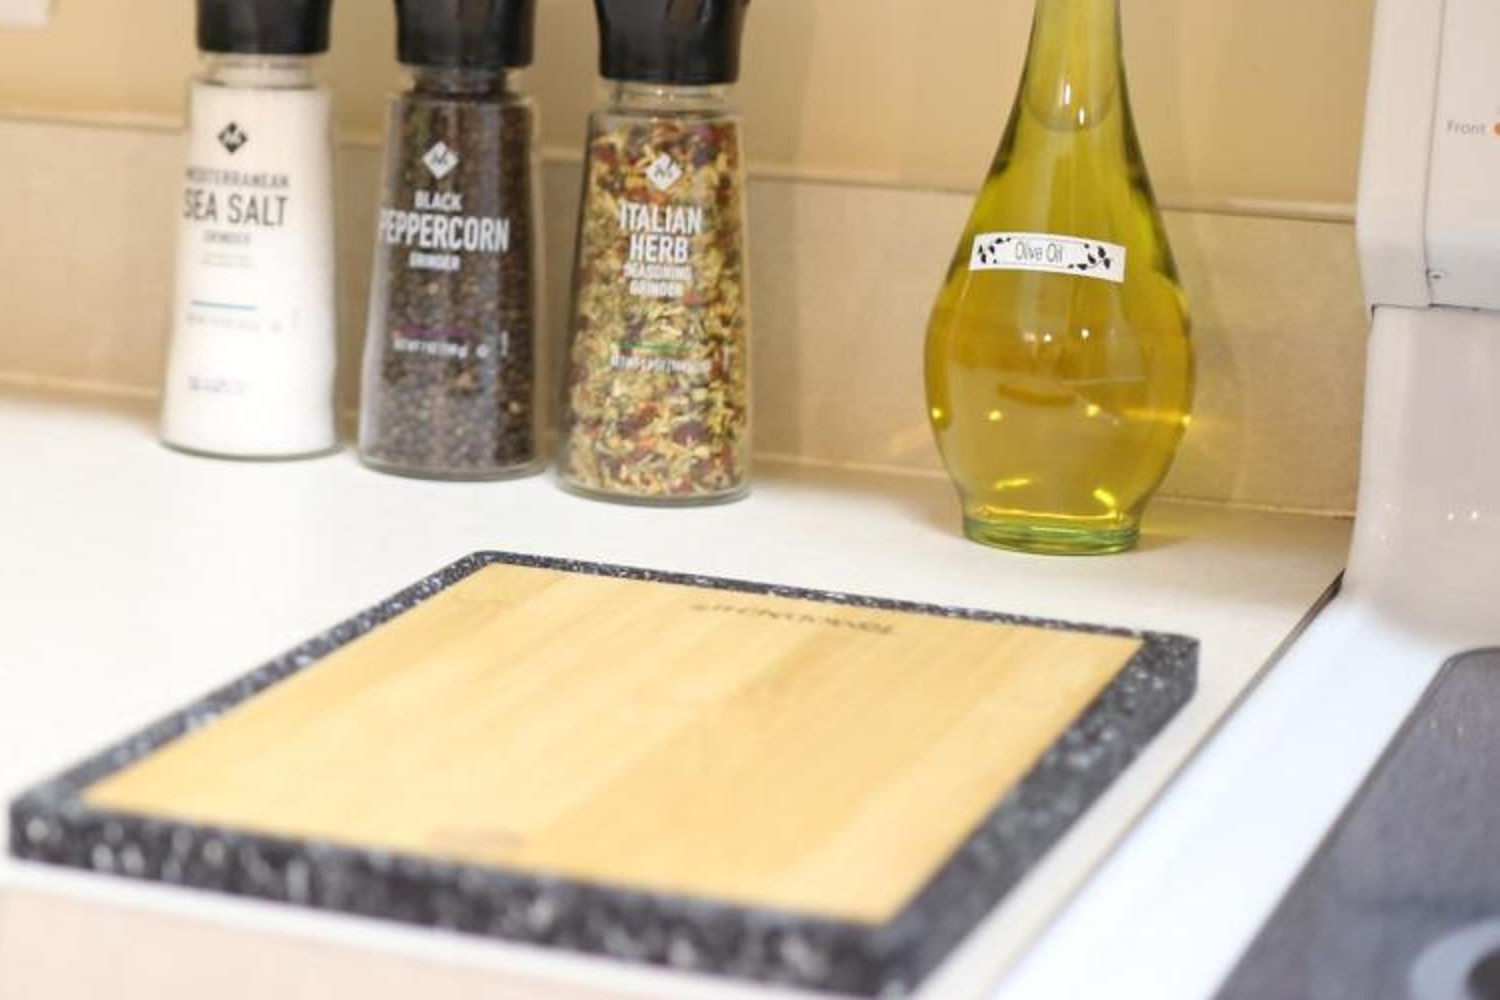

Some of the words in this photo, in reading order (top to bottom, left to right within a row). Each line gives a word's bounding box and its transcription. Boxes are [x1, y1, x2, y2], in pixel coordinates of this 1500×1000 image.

[183, 187, 218, 222] SEA
[227, 193, 289, 227] SALT
[414, 189, 463, 212] BLACK
[380, 208, 510, 253] PEPPERCORN
[619, 201, 703, 234] ITALIAN
[630, 233, 689, 263] HERB
[1015, 240, 1043, 262] Olive
[1046, 242, 1063, 263] Oil
